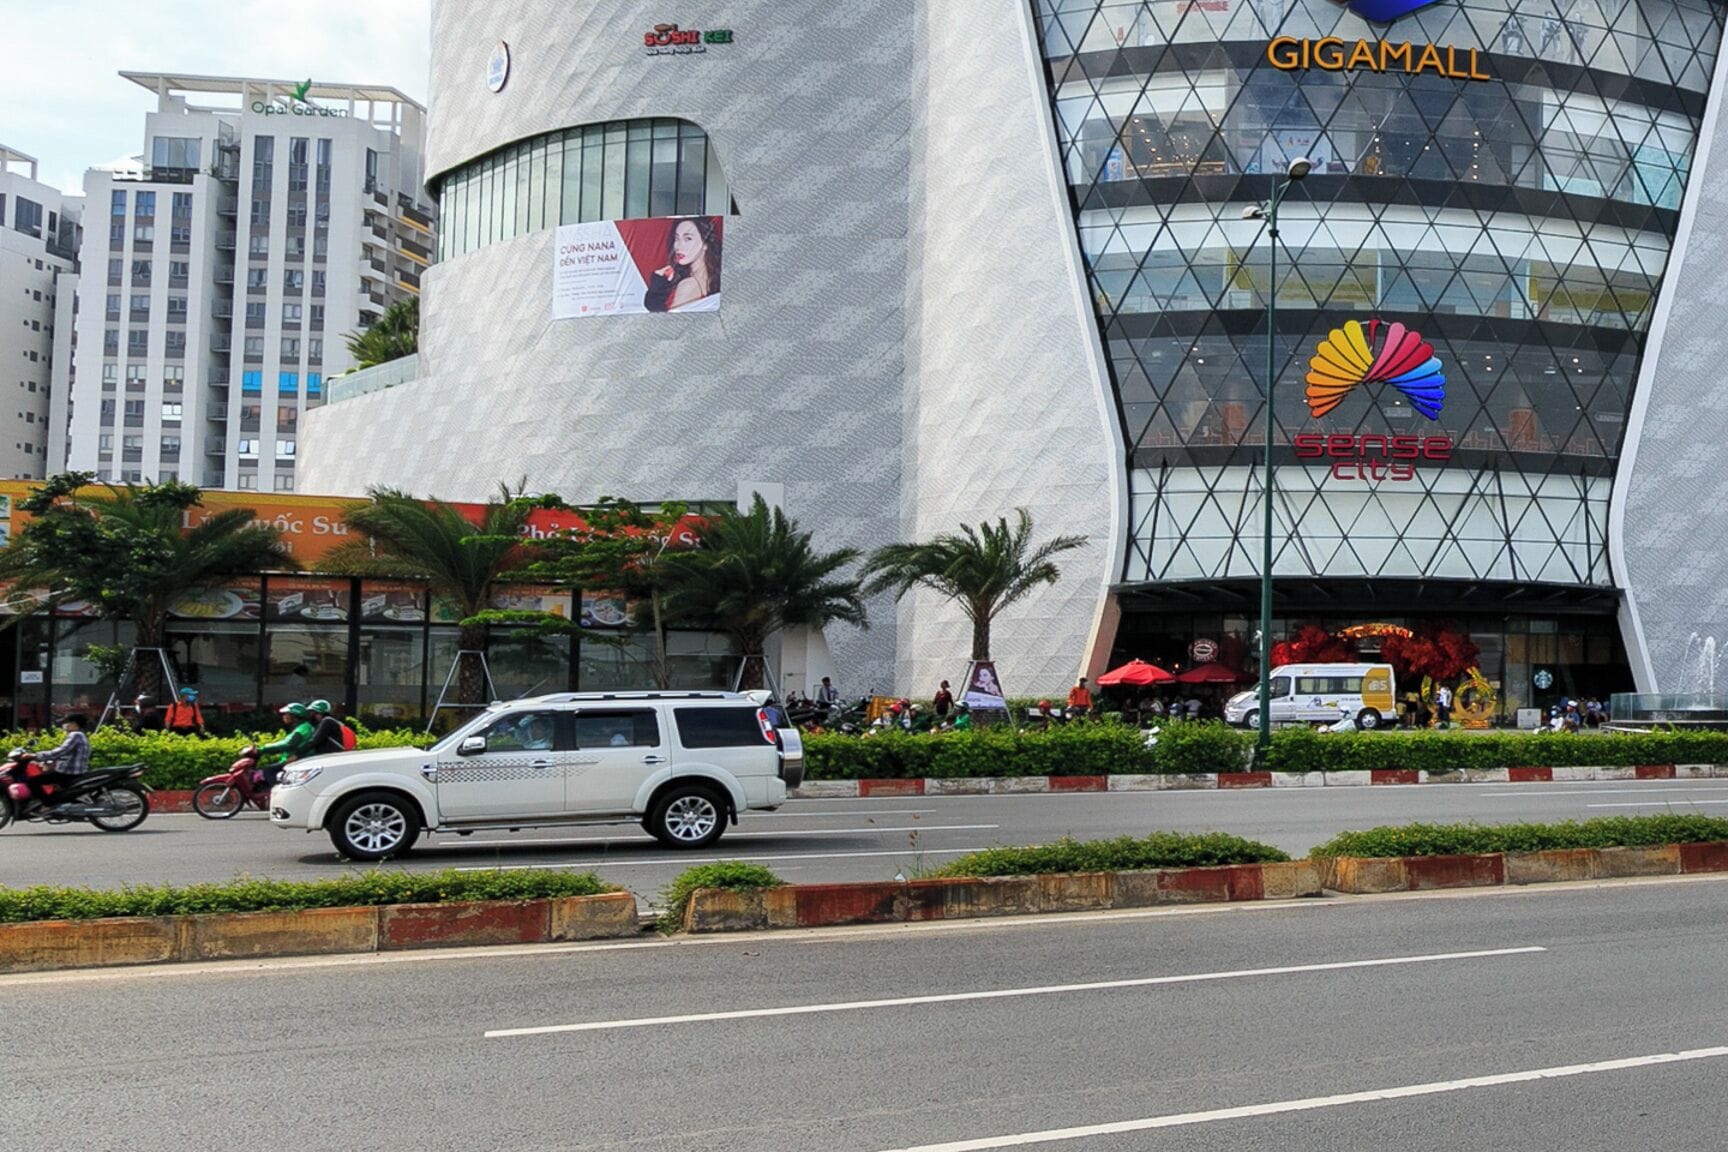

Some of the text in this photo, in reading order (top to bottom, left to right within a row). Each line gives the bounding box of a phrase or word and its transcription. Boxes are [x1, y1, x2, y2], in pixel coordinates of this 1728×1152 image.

[704, 29, 734, 44] KEI
[1267, 35, 1491, 81] GIGAMALL
[251, 101, 349, 119] Opal Garden
[587, 240, 616, 252] NANA
[597, 253, 618, 263] NAM
[1294, 432, 1455, 459] sense
[1332, 457, 1417, 482] city
